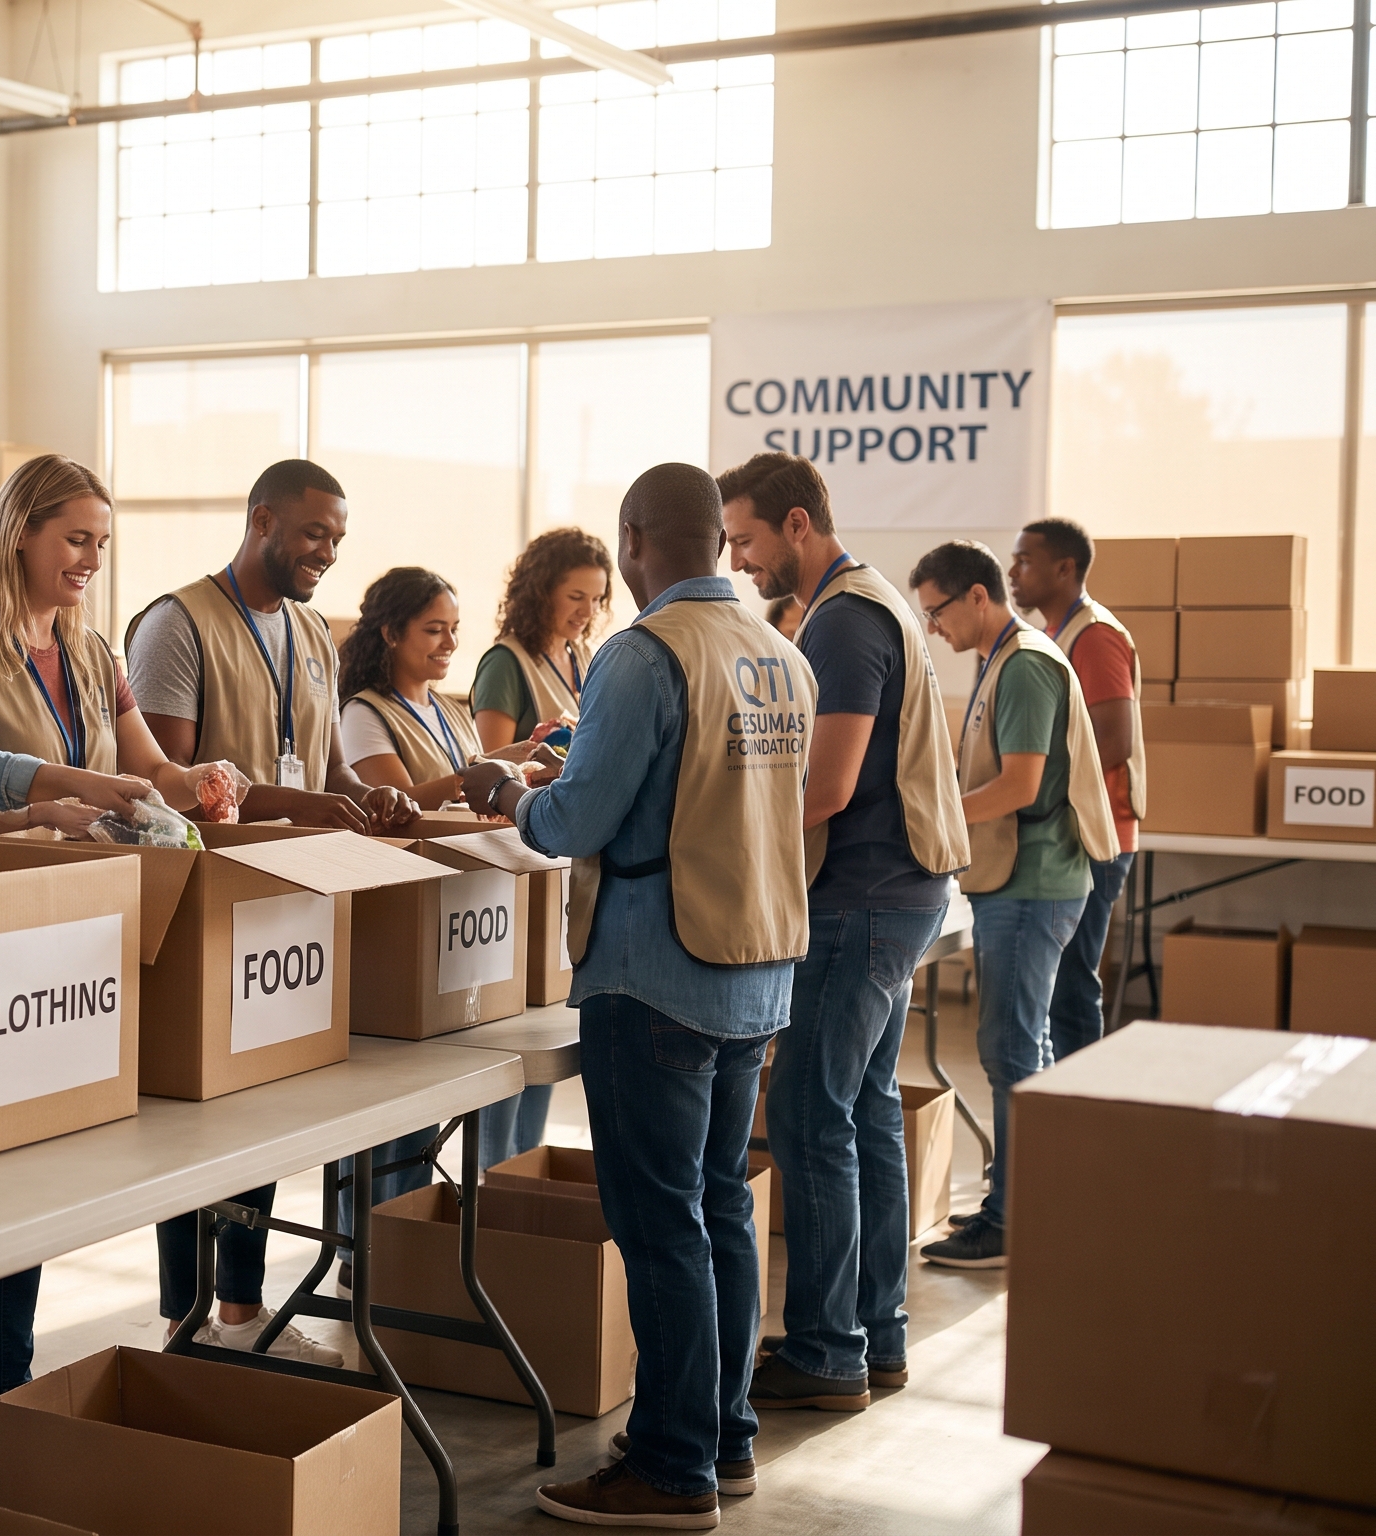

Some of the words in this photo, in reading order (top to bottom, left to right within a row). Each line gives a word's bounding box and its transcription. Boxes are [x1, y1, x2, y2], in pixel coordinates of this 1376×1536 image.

[725, 370, 1032, 415] COMMUNITY
[764, 423, 987, 463] SUPPORT
[735, 656, 794, 708] QTI
[727, 712, 805, 734] CESUMAS
[1295, 785, 1365, 806] FOOD
[448, 905, 508, 951] FOOD
[244, 942, 324, 1000] FOOD
